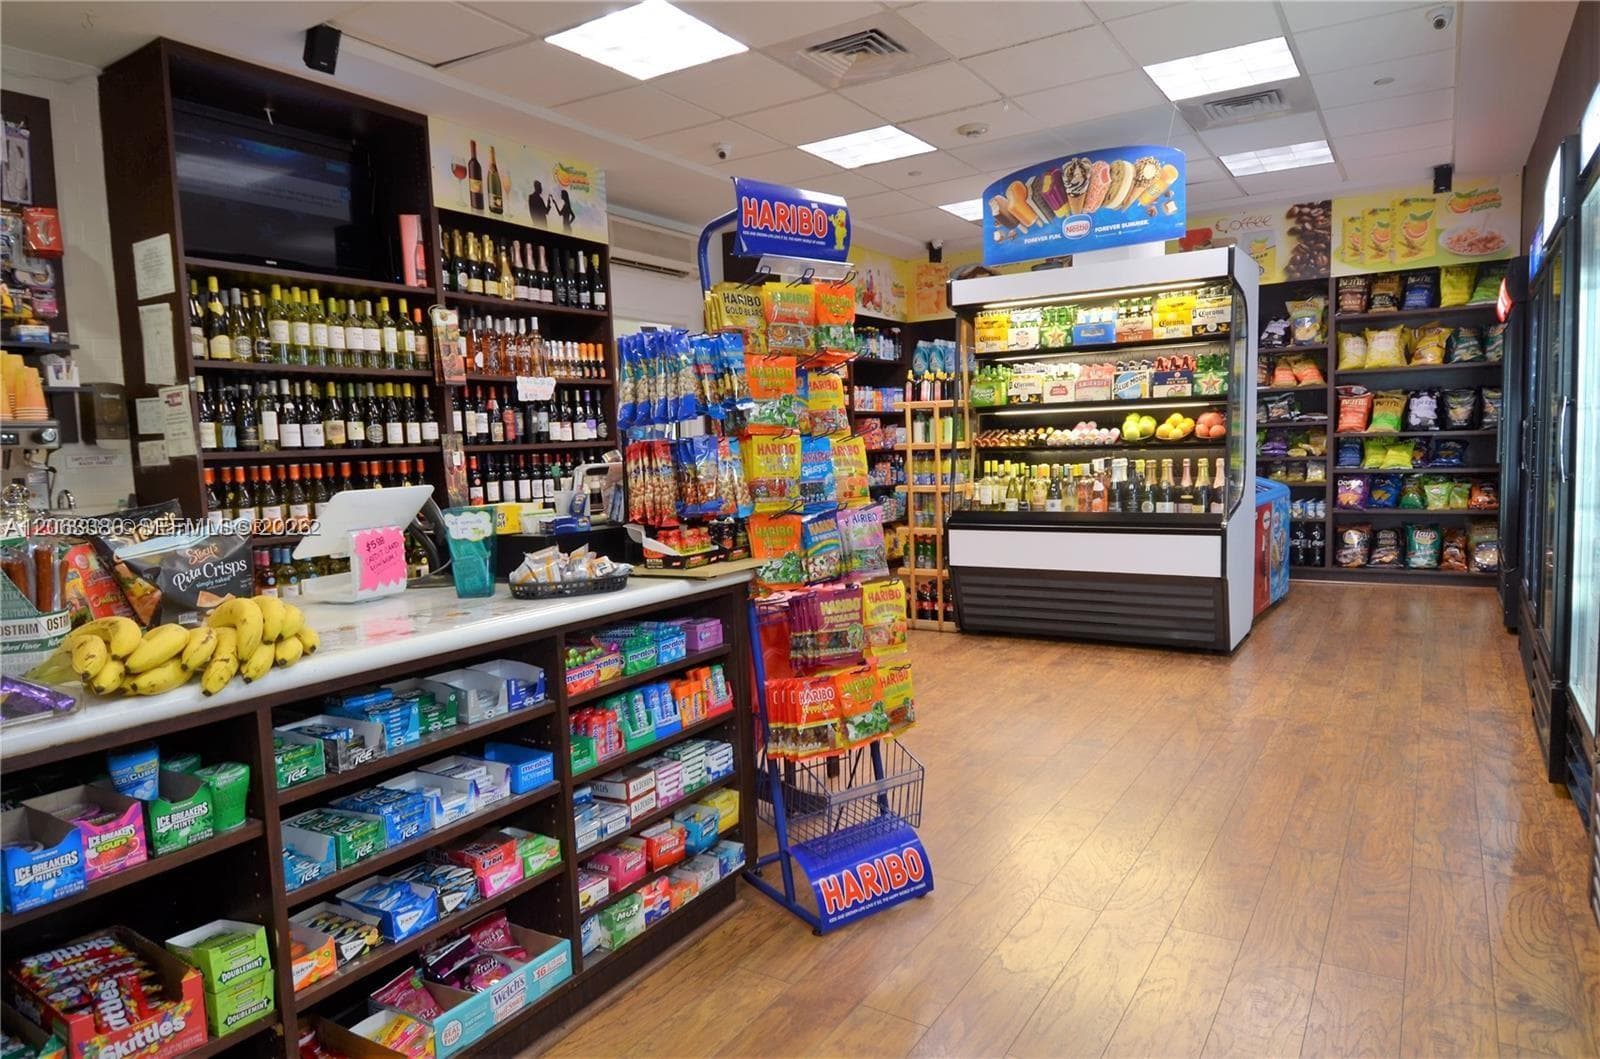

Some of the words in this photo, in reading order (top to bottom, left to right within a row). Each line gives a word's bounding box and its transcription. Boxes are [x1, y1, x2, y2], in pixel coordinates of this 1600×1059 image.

[741, 195, 828, 238] HARIBO
[1095, 223, 1120, 233] FOREVER
[723, 292, 761, 307] HARIBO
[1198, 308, 1224, 318] Corona
[1159, 319, 1185, 328] Corona
[757, 443, 795, 456] HARIBO
[185, 543, 218, 565] Stacy's
[172, 566, 202, 592] Pita
[202, 559, 248, 578] Crisps
[868, 588, 901, 602] HARIBO
[661, 640, 684, 650] mentos
[629, 649, 655, 662] mentos
[880, 670, 910, 688] HARIBO
[799, 687, 835, 705] HARIBO
[354, 748, 374, 766] ICE
[521, 758, 550, 773] mentos
[287, 766, 309, 784] ICE
[156, 815, 171, 831] ICE
[171, 802, 208, 824] BREAKERS
[172, 819, 196, 832] MINTS
[100, 823, 136, 844] BREAKERS
[401, 822, 419, 840] ICE
[355, 841, 374, 860] ICE
[15, 865, 32, 883] ICE
[32, 850, 79, 876] BREAKERS
[34, 868, 64, 883] MINTS
[300, 863, 321, 884] ICE
[819, 847, 924, 914] HARIBO
[221, 956, 263, 983] DOUBLEMINT
[492, 974, 526, 1006] Welch's
[227, 998, 269, 1024] DOUBLEMINT
[99, 1016, 185, 1059] Skittles
